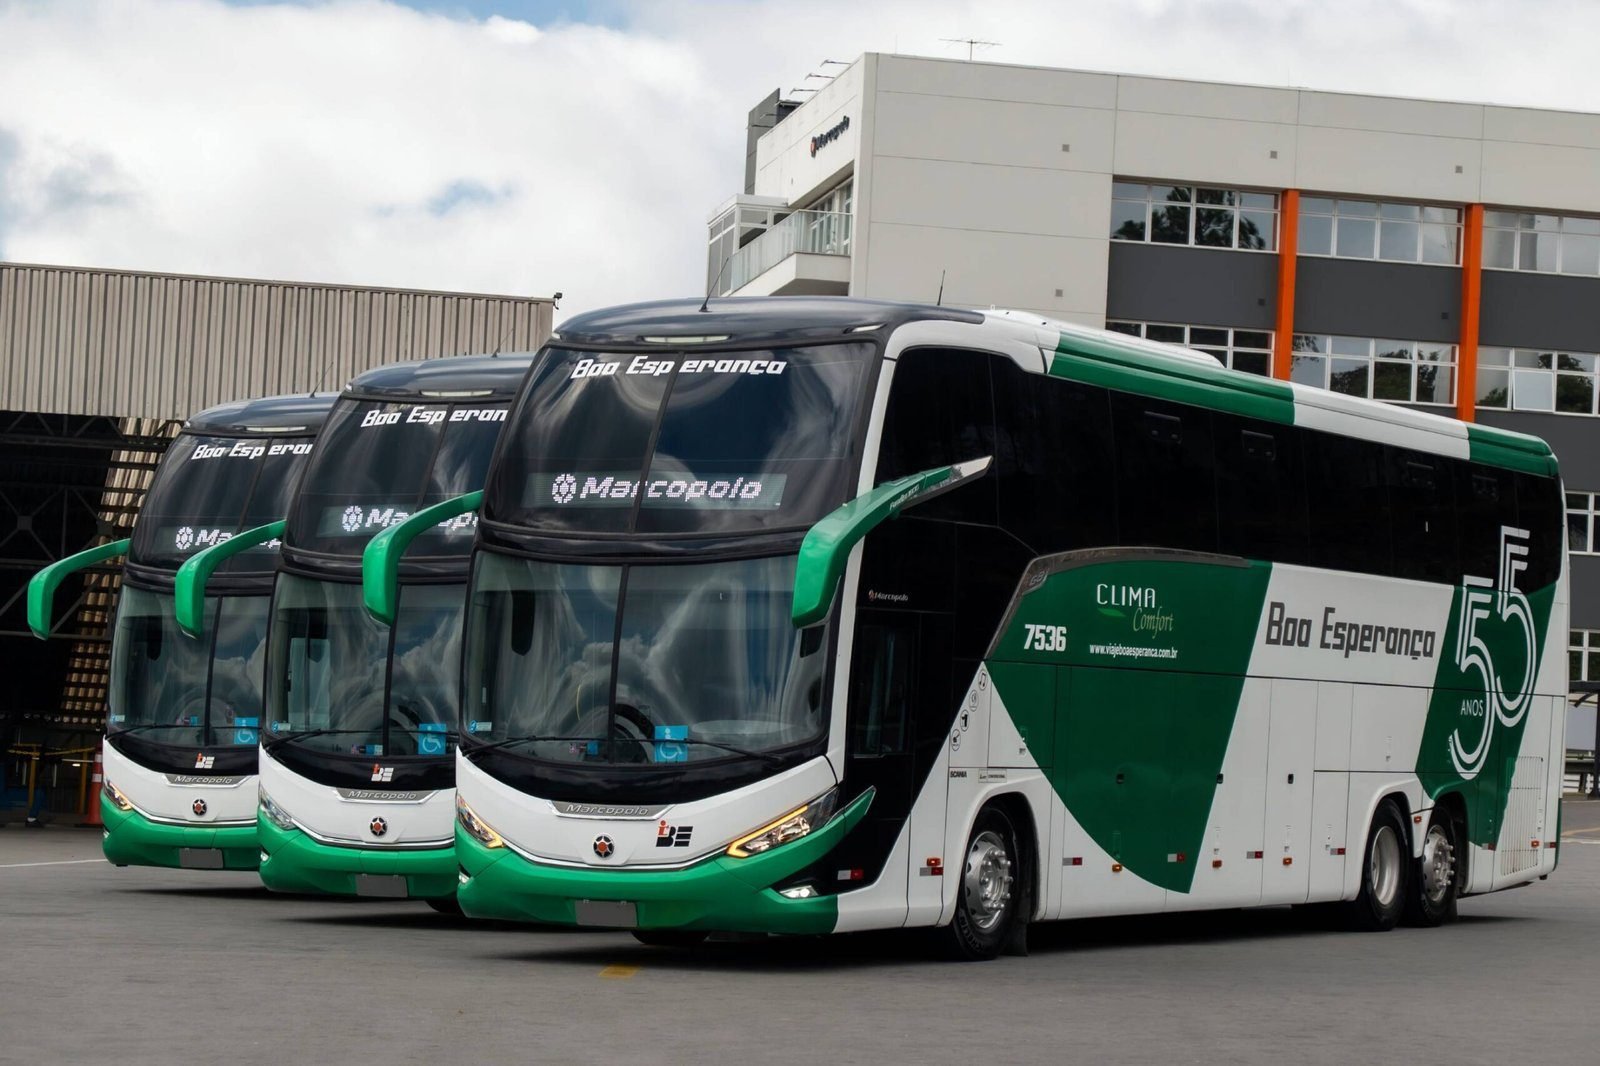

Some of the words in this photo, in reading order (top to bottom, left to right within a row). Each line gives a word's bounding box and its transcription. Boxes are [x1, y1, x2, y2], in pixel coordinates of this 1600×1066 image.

[570, 358, 620, 379] Boa
[360, 409, 402, 428] Boa
[191, 444, 226, 460] Boa
[579, 477, 762, 502] Marcopolo
[1096, 583, 1156, 608] CLIMA
[1132, 606, 1174, 639] Comfort
[1265, 601, 1312, 648] Boa
[1319, 606, 1436, 660] Esperança
[1023, 623, 1067, 652] 7536
[1089, 642, 1178, 659] www.viajeboaesperanca.com.br
[1460, 699, 1484, 717] ANOS
[174, 775, 232, 785] Marcopolo
[348, 789, 417, 800] Marcopolo
[565, 804, 649, 816] Marcopolo
